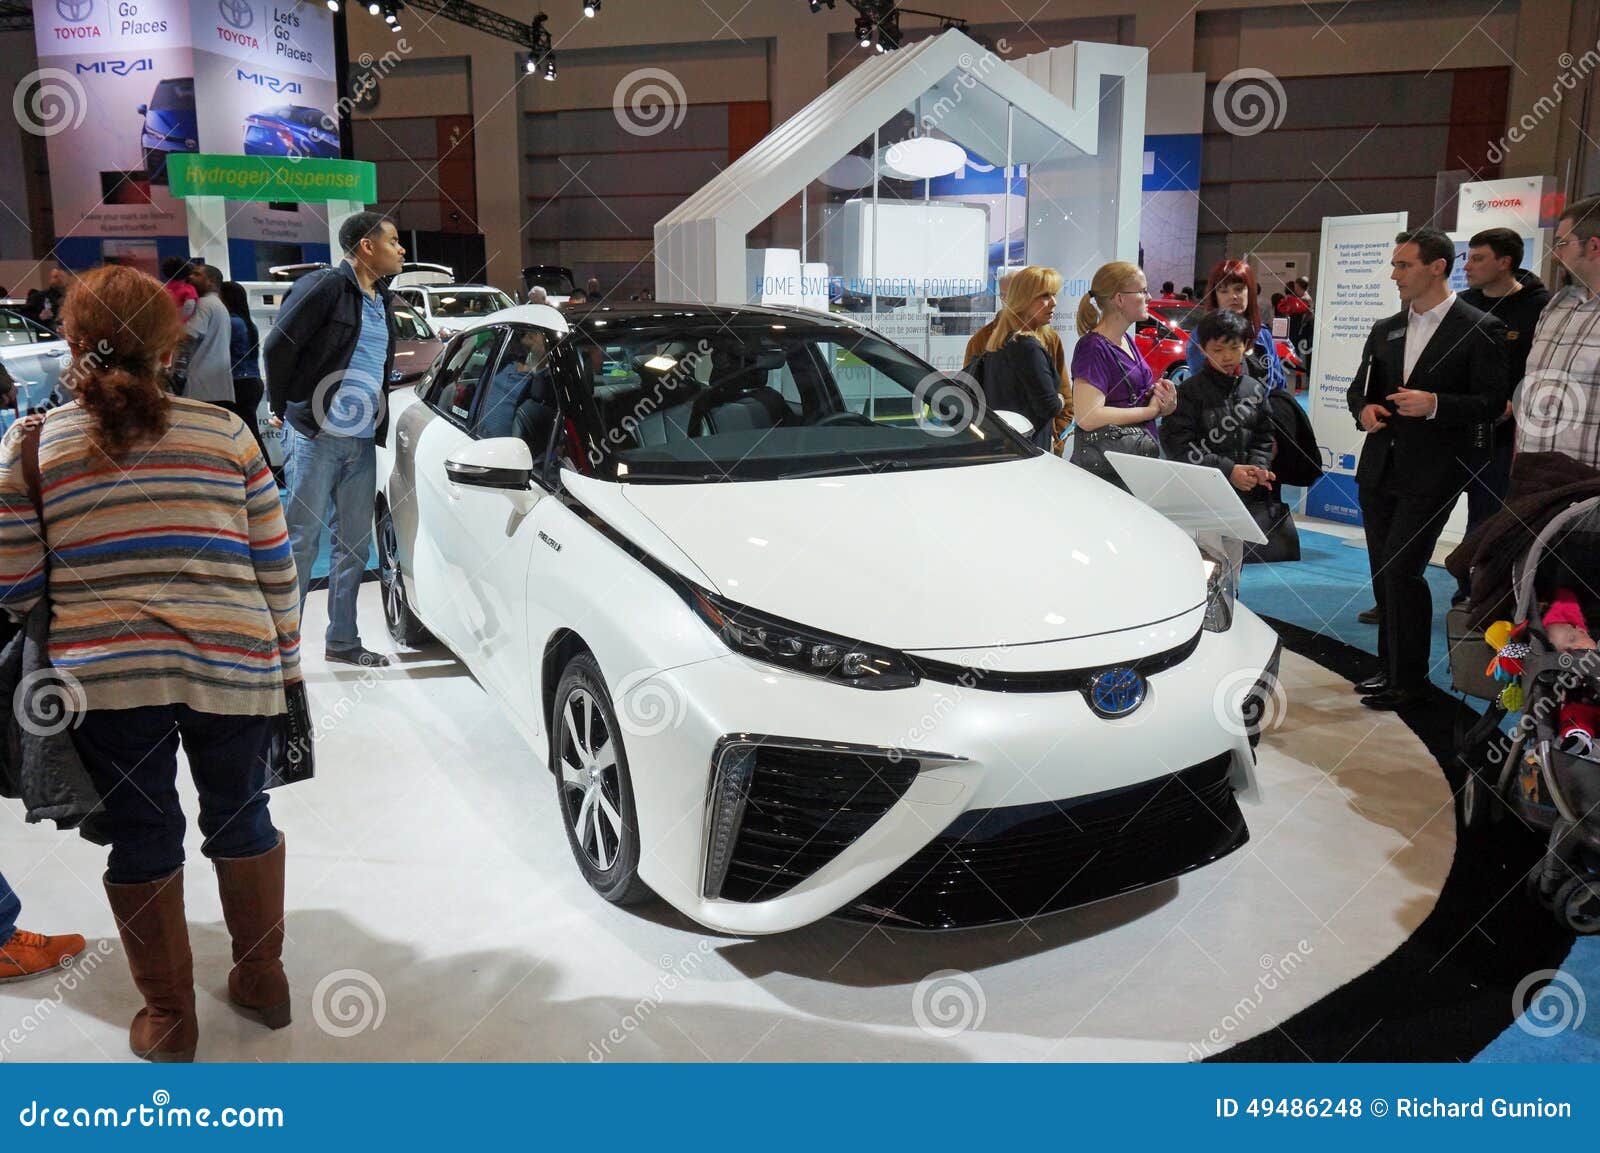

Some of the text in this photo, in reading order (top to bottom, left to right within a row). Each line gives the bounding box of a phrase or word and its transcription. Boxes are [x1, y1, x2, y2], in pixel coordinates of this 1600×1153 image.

[118, 2, 138, 17] Go
[273, 7, 300, 28] Let's
[54, 26, 102, 40] TOYOTA
[121, 20, 168, 35] Places
[274, 24, 290, 41] Go
[216, 26, 259, 50] TOYOTA
[276, 42, 313, 63] Places
[76, 58, 153, 76] MIRAI
[237, 69, 302, 94] MIRAI
[185, 164, 361, 188] Hydrogen Dispenser
[1487, 198, 1521, 208] TOYOTA
[755, 277, 795, 296] HOME
[800, 276, 844, 296] SWEET
